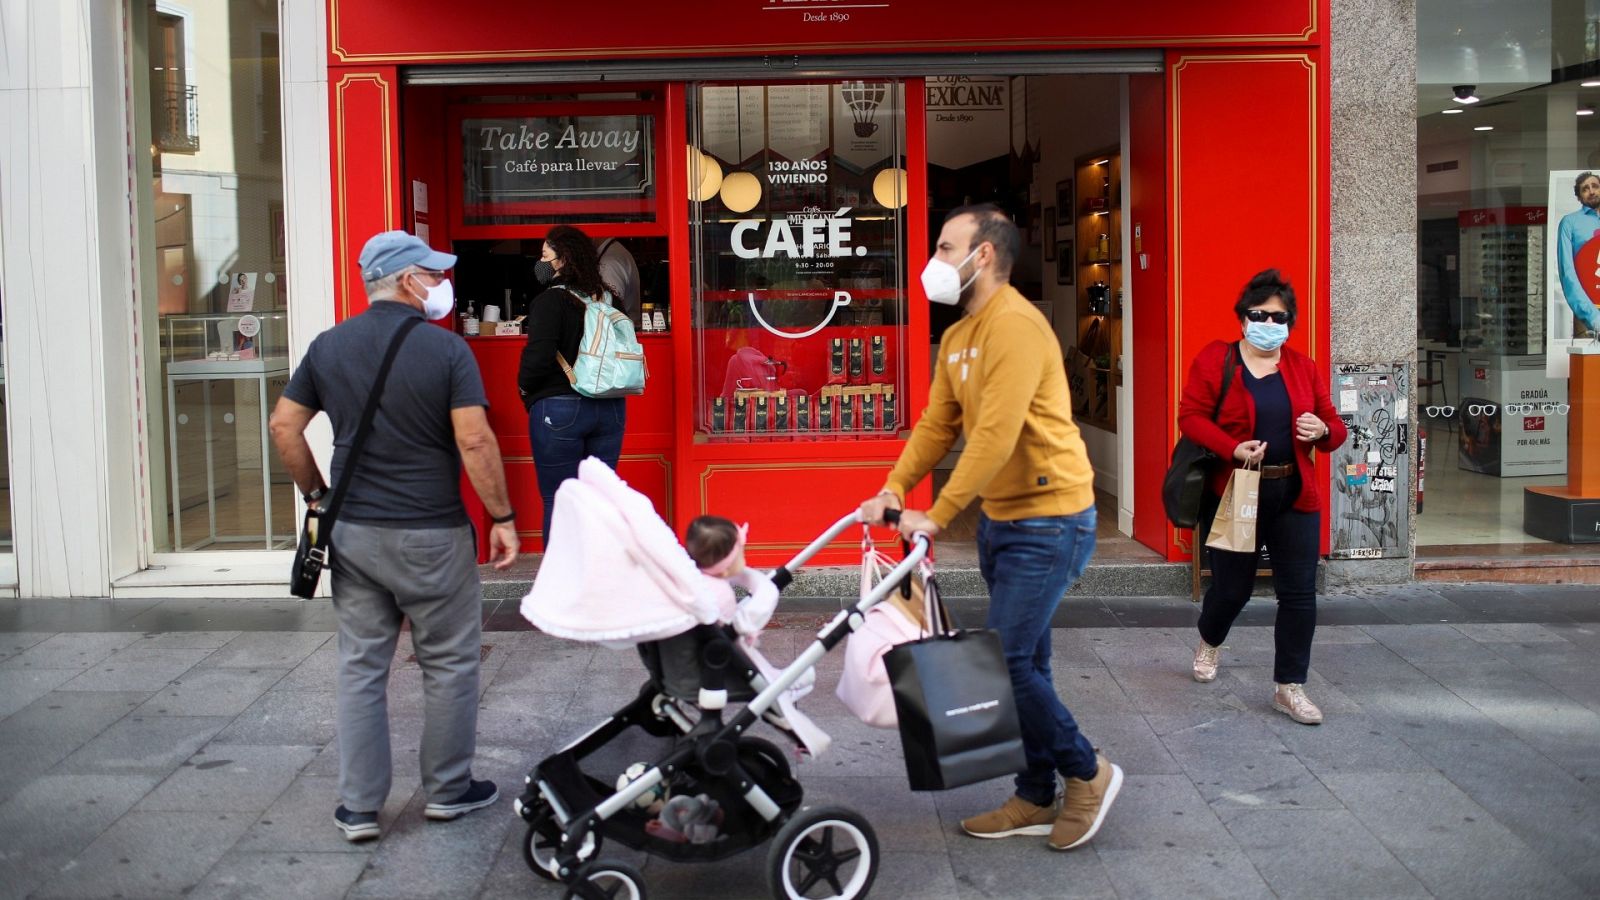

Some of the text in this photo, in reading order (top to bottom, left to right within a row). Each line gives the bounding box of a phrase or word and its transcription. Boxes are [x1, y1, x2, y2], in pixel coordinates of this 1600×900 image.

[803, 12, 850, 23] Desde 1890
[926, 86, 1003, 106] EXICANA
[936, 114, 974, 123] Desde 1890
[480, 124, 640, 153] Take Away
[504, 158, 618, 175] Café para llevar
[768, 158, 828, 171] 130 AÑOS
[767, 172, 828, 184] VIVIENDO
[1520, 389, 1549, 399] GRADÚA
[1540, 437, 1551, 445] MÁS
